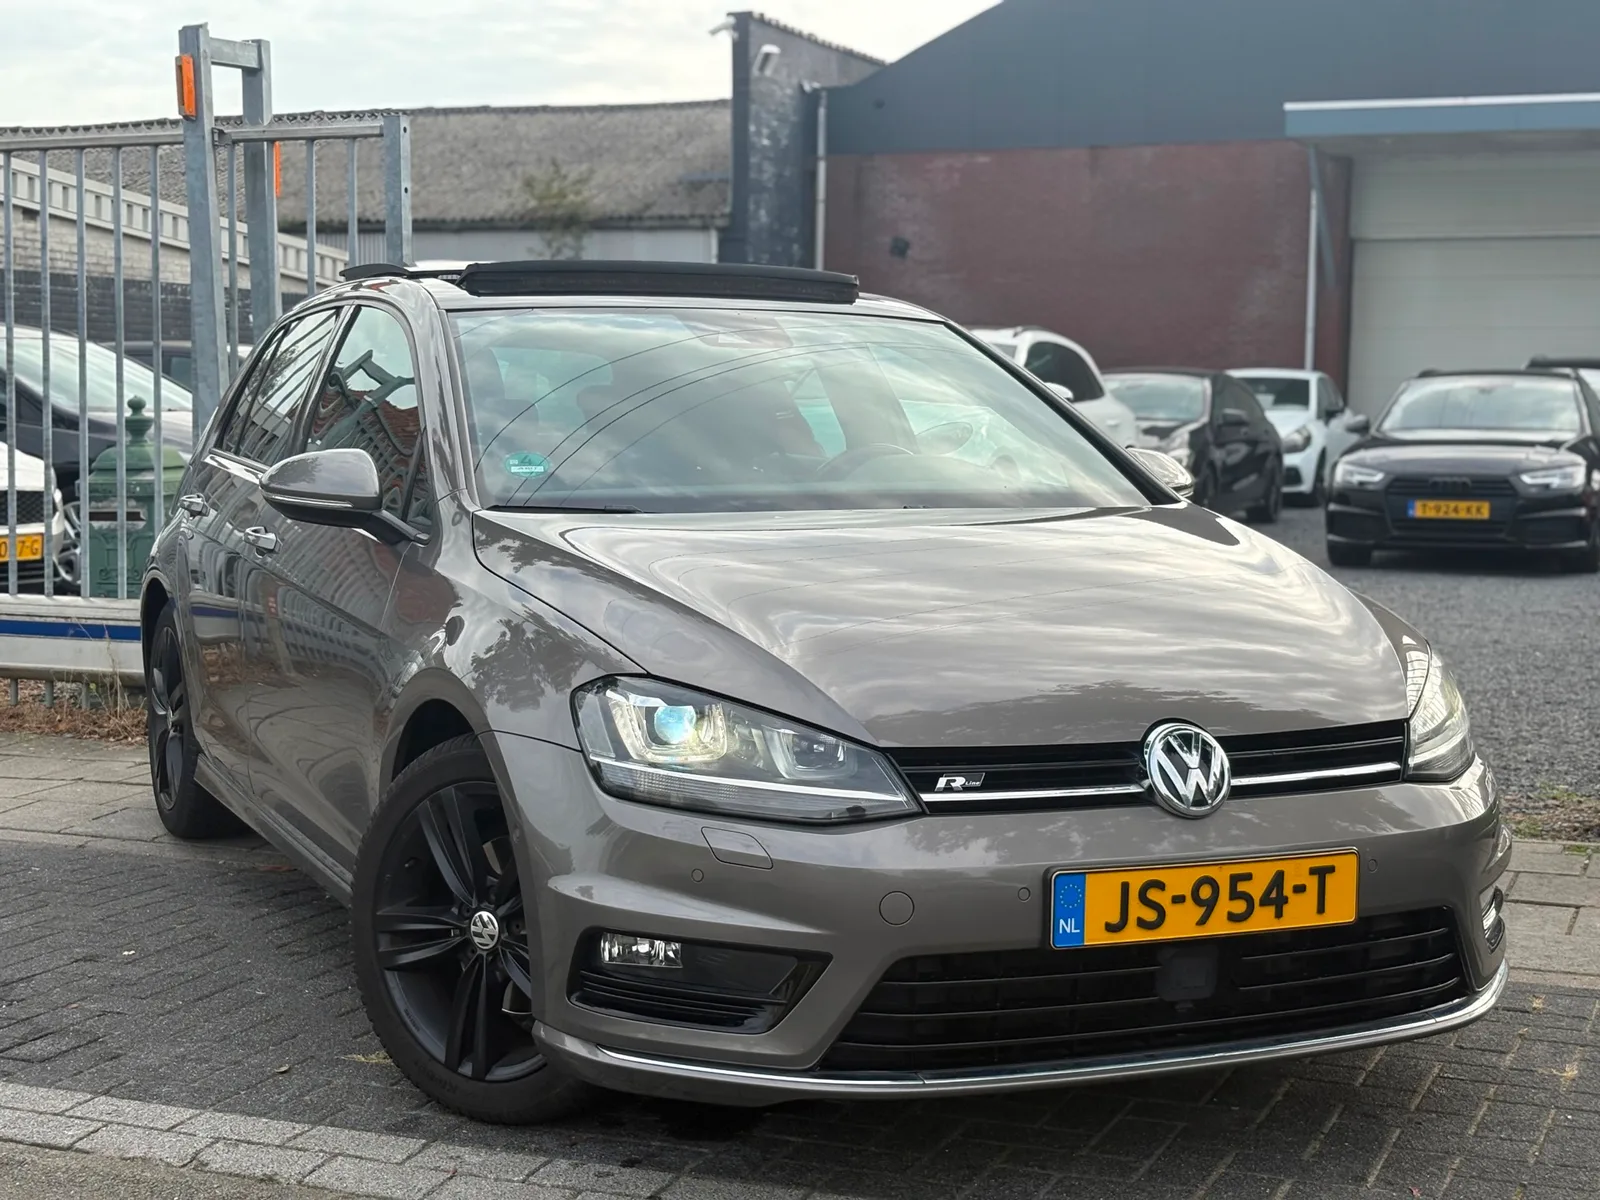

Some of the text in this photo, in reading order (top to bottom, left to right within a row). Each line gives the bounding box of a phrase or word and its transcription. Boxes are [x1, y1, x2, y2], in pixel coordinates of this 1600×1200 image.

[1420, 503, 1485, 517] T-924-KK
[0, 540, 40, 558] 07-G
[1059, 864, 1336, 934] NL JS-954-T
